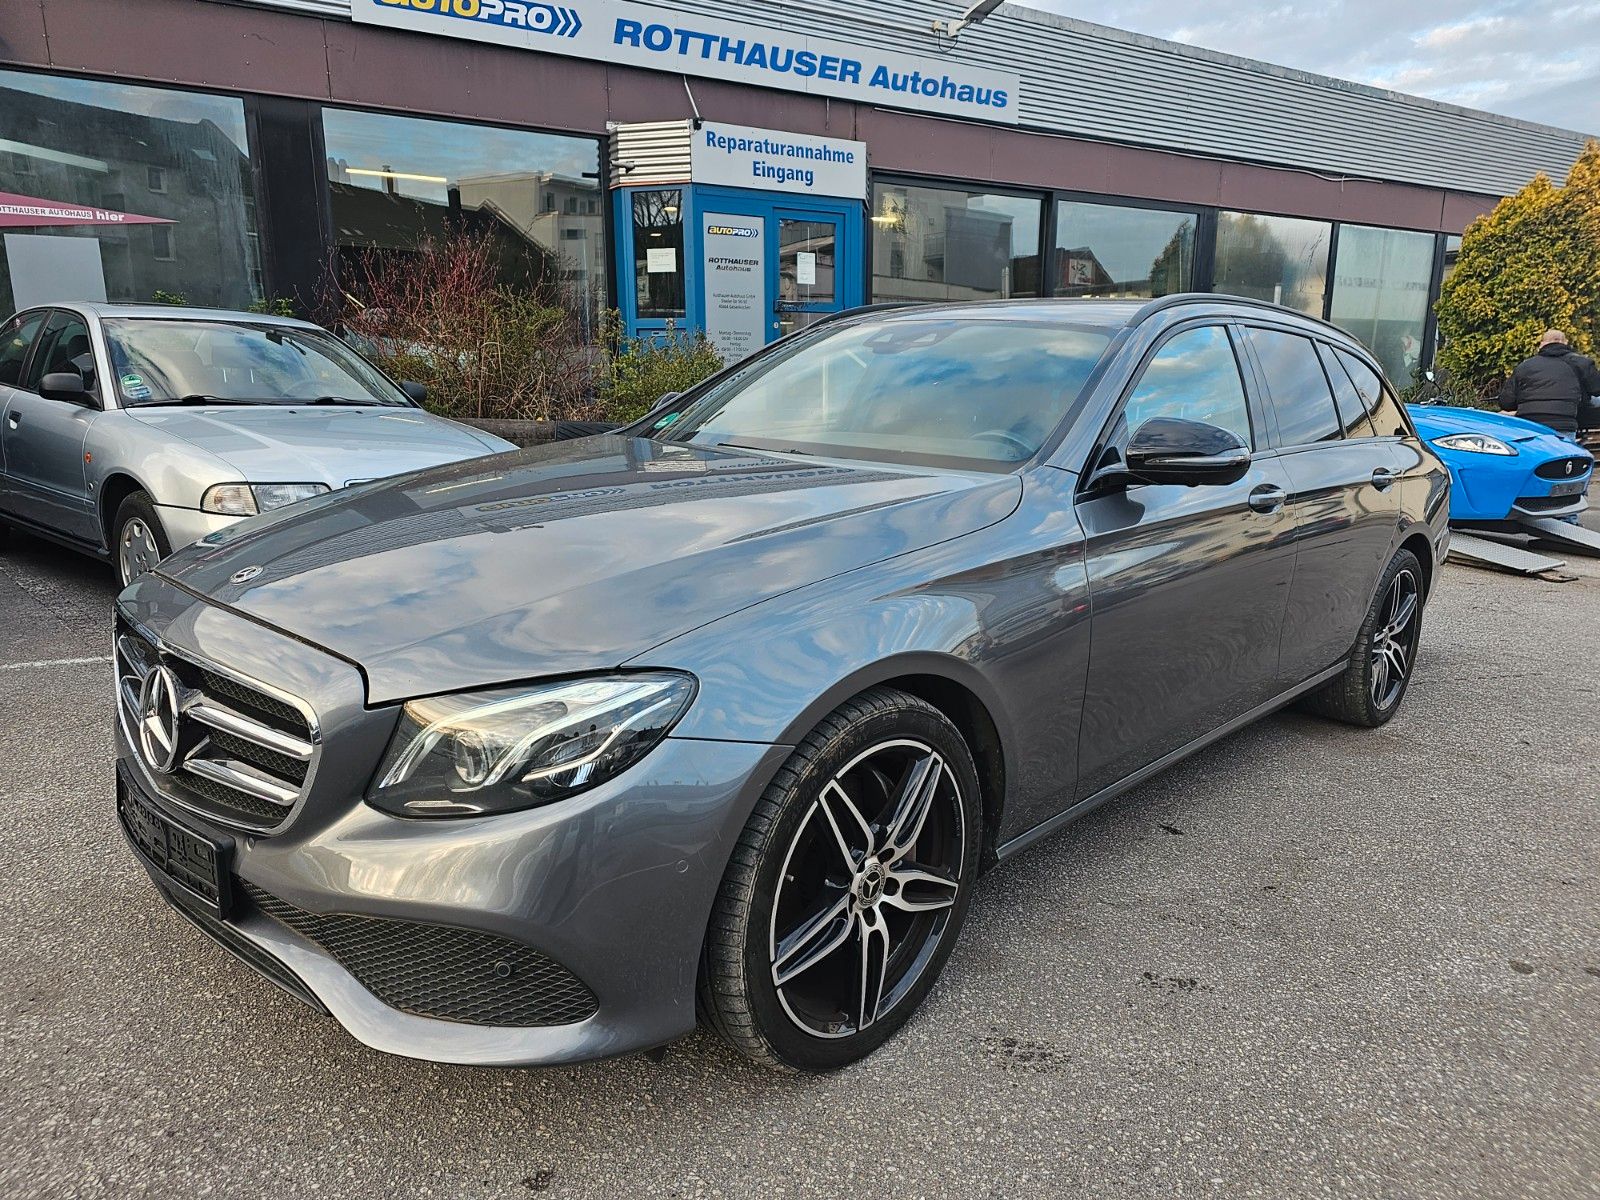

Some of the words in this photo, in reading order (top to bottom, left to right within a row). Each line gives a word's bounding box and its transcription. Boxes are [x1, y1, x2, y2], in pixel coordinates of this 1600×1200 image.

[381, 0, 552, 30] TOPRO
[613, 19, 862, 84] ROTTHAUSER
[869, 66, 1008, 108] Autohaus
[706, 130, 854, 164] Reparaturannahme
[752, 161, 814, 186] Eingang
[0, 205, 46, 215] TTHAUSER
[49, 208, 92, 218] AUTOHAUS
[96, 211, 125, 221] hier
[708, 257, 759, 266] ROTTHAUSER
